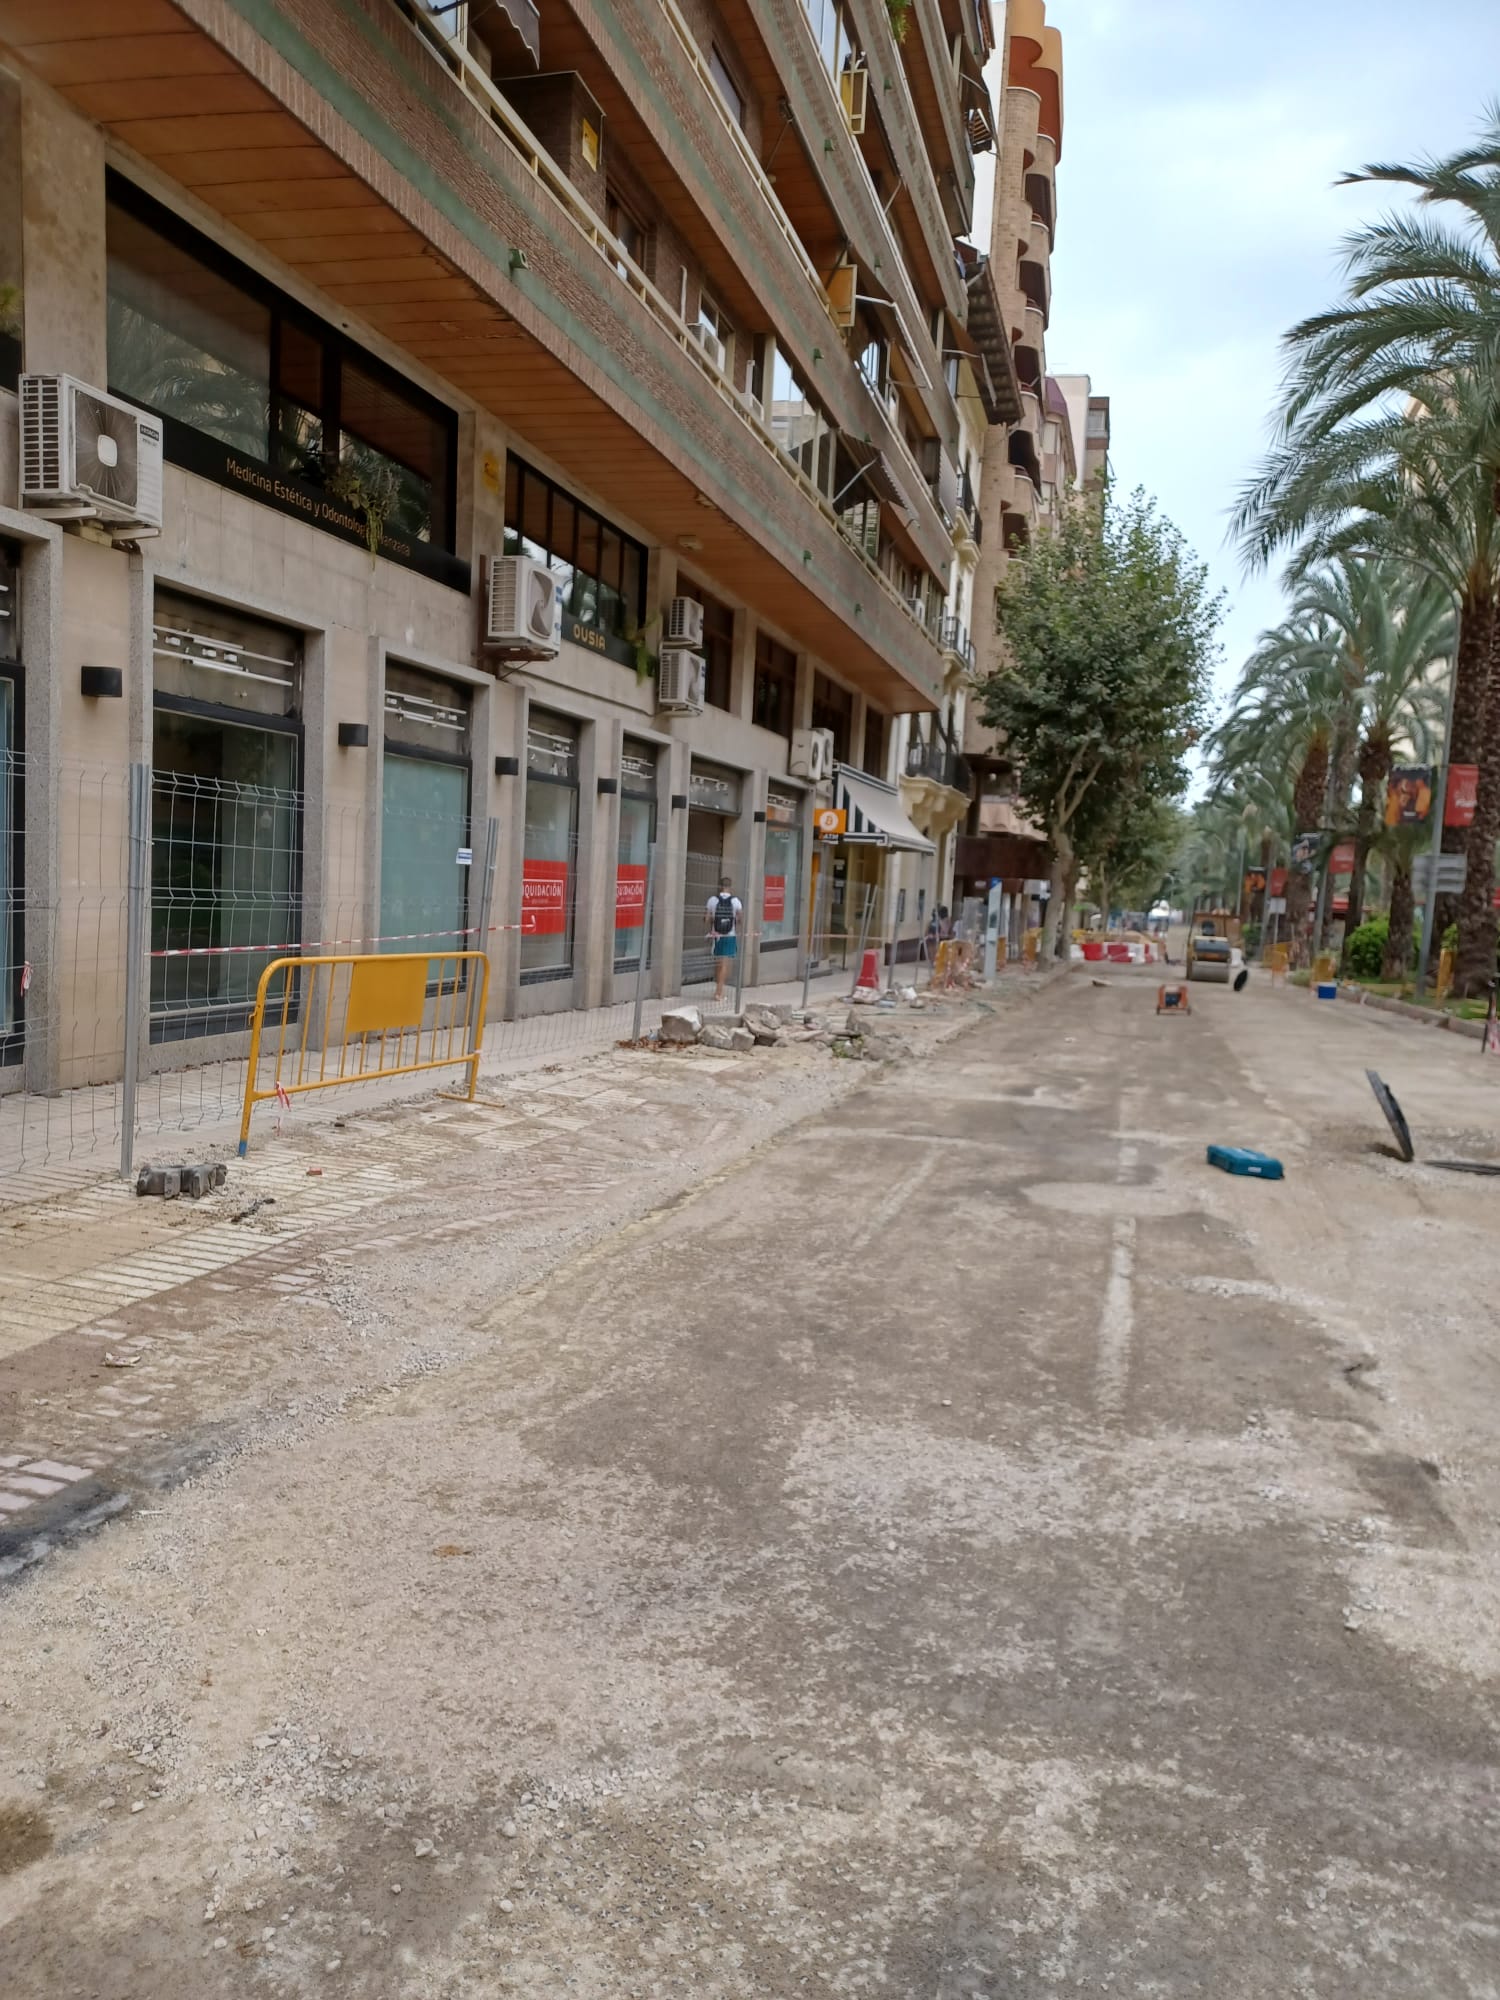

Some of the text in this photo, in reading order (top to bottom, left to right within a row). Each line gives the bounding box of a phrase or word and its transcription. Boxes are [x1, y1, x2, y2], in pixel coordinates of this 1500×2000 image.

[226, 457, 272, 493] Medicina
[274, 480, 313, 511] Estética
[313, 503, 320, 518] y
[573, 623, 606, 651] OUSIA
[521, 883, 562, 899] IQUIDACIÓN
